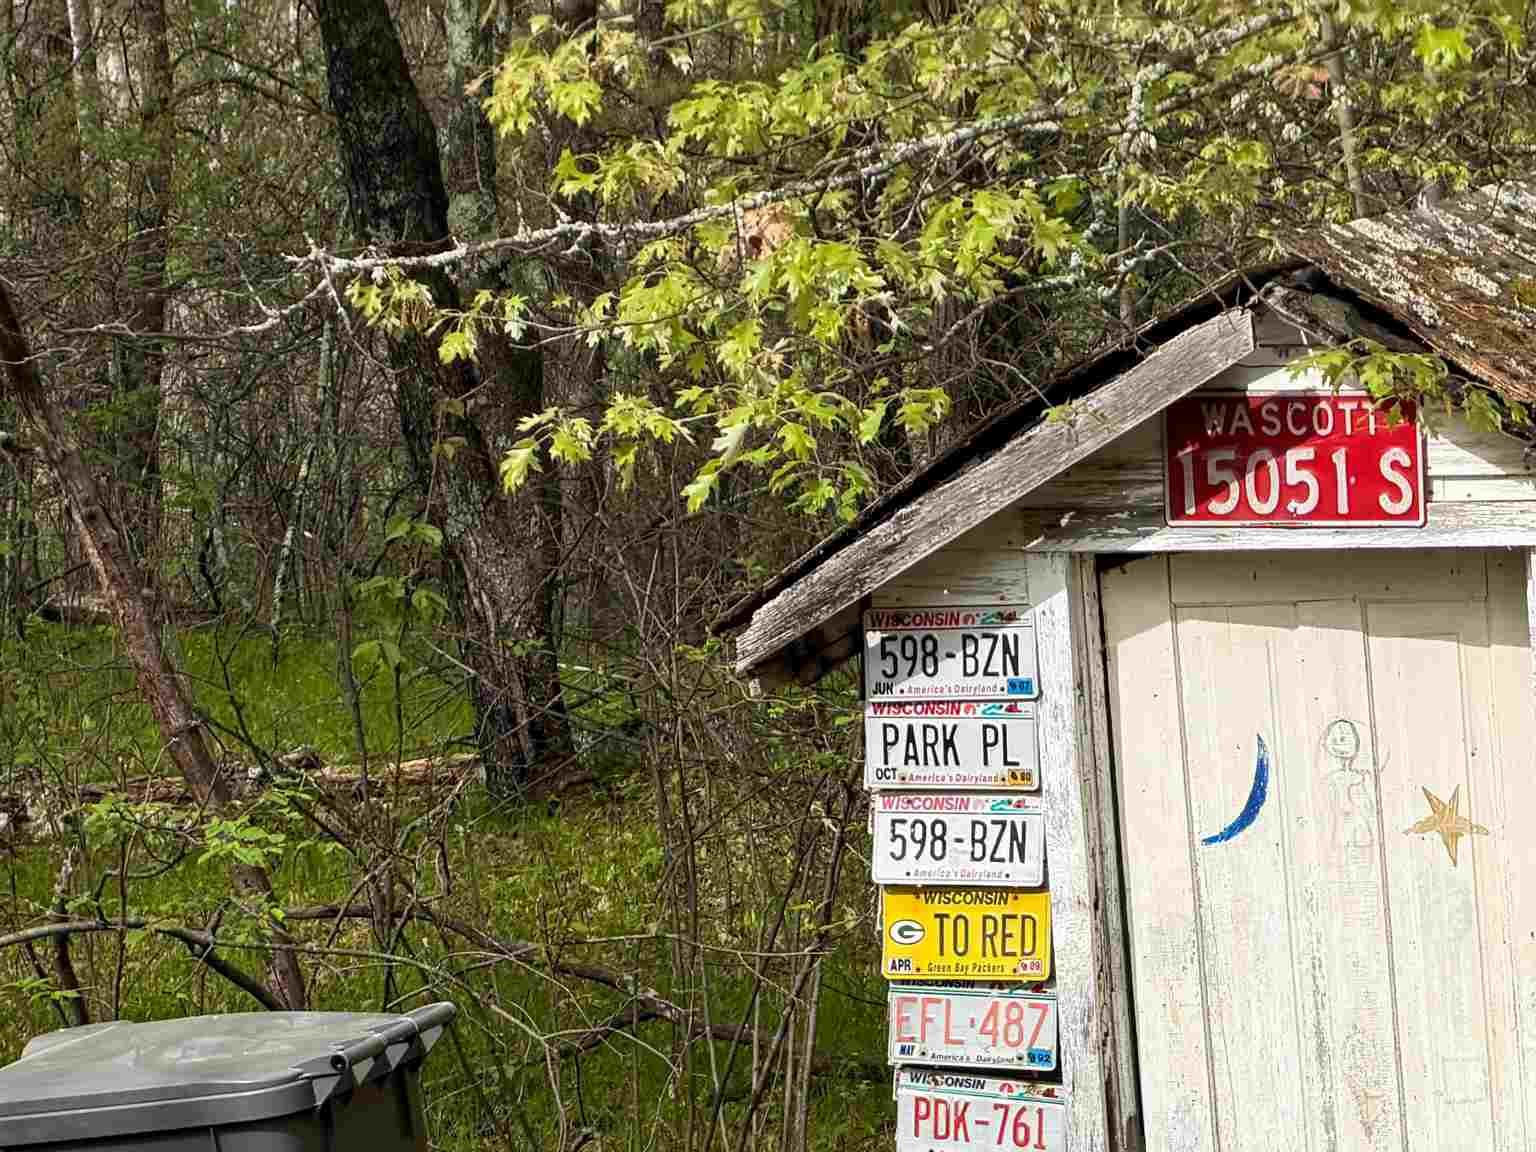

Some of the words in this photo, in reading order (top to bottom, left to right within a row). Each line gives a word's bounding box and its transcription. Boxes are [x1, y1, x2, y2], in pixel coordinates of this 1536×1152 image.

[1201, 400, 1378, 436] WASCOTT
[1177, 447, 1349, 515] 15051
[1379, 447, 1413, 515] S
[871, 612, 960, 626] WISCONSIN
[880, 634, 1019, 678] 598-BZN
[872, 682, 893, 695] JUN
[908, 683, 952, 694] America's
[955, 684, 997, 696] Dairyland
[872, 702, 960, 715] WISCONSIN
[882, 723, 960, 766] PARK
[982, 723, 1020, 766] PL
[876, 768, 896, 780] OCT
[909, 774, 954, 783] America's
[956, 774, 998, 785] Dairyland
[882, 798, 969, 811] WISCONSIN
[889, 819, 1027, 863] 598-BZN
[914, 869, 958, 877] America's
[924, 892, 1009, 905] WISCONSIN
[934, 913, 969, 957] TO
[982, 914, 1037, 958] RED
[890, 959, 911, 972] APR
[928, 962, 952, 973] Green
[955, 962, 969, 974] Bay
[972, 962, 1005, 973] Packers
[930, 1053, 970, 1062] America's
[910, 1072, 986, 1089] WISCONSIN
[913, 1096, 1047, 1150] PDK-761
